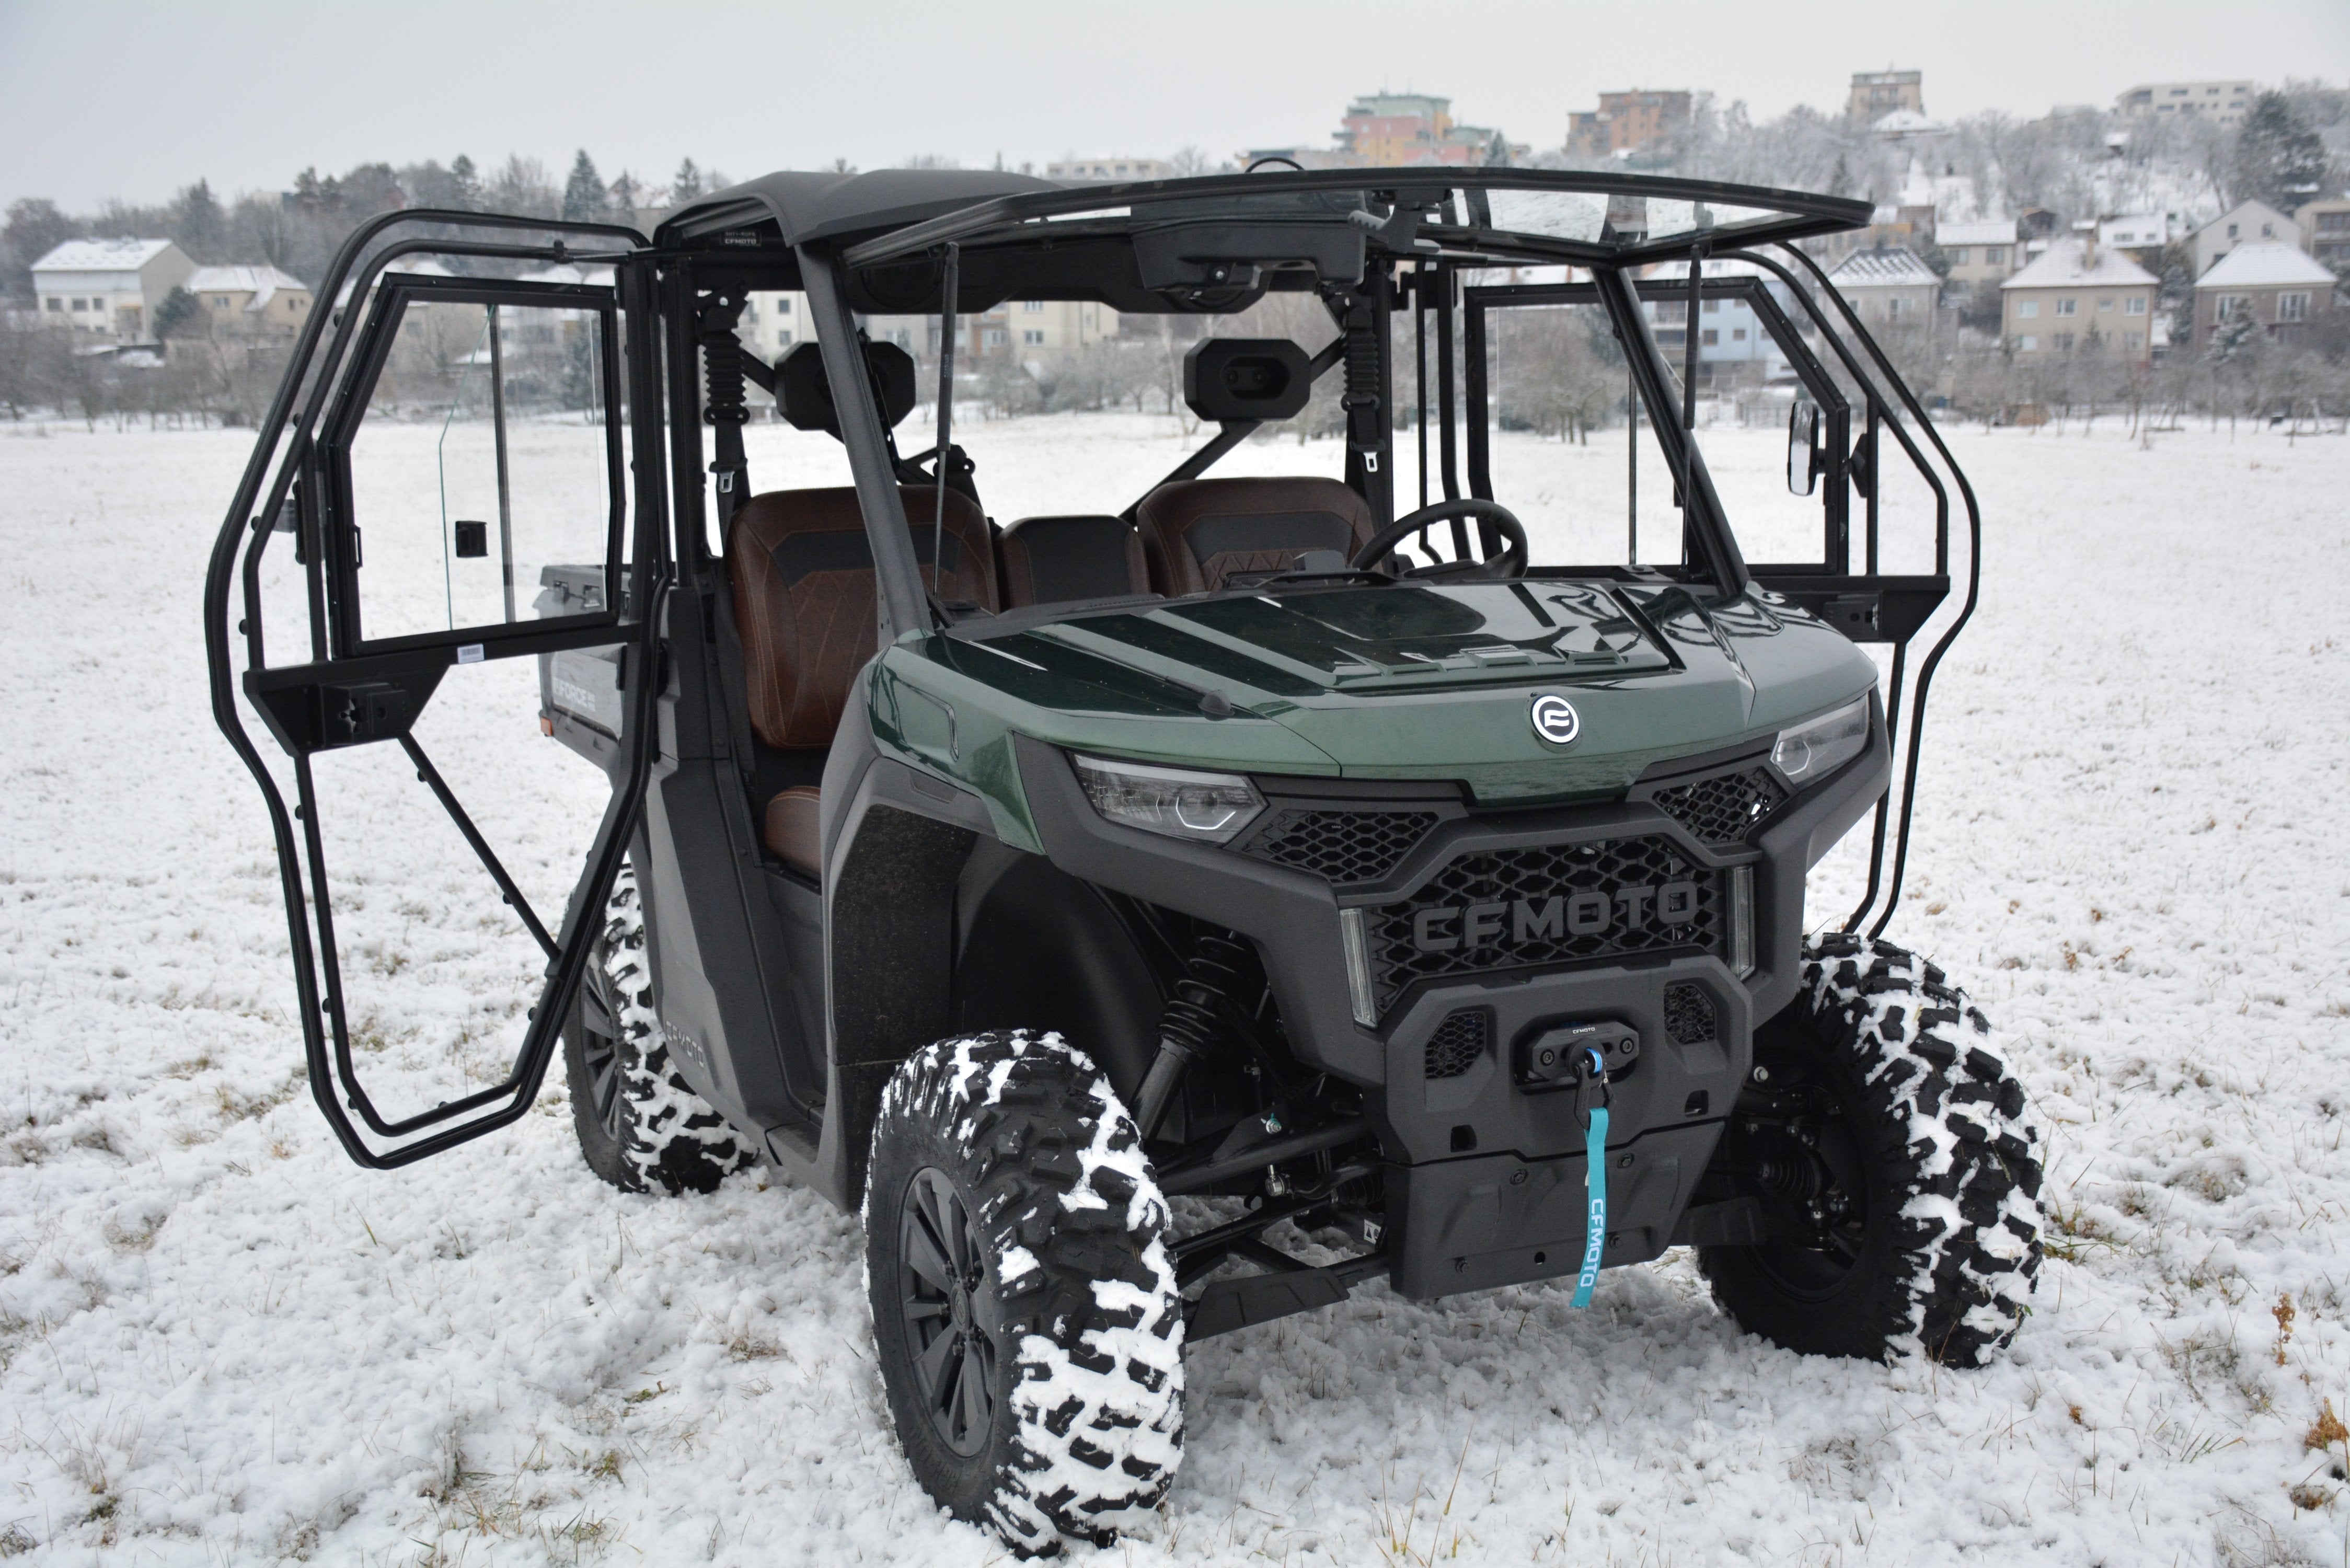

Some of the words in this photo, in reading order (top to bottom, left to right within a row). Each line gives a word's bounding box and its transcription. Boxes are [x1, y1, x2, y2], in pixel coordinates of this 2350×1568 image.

[1413, 881, 1698, 952] CFMOTO
[665, 1020, 705, 1068] CFMOTO
[1580, 1198, 1604, 1288] CFMOTO
